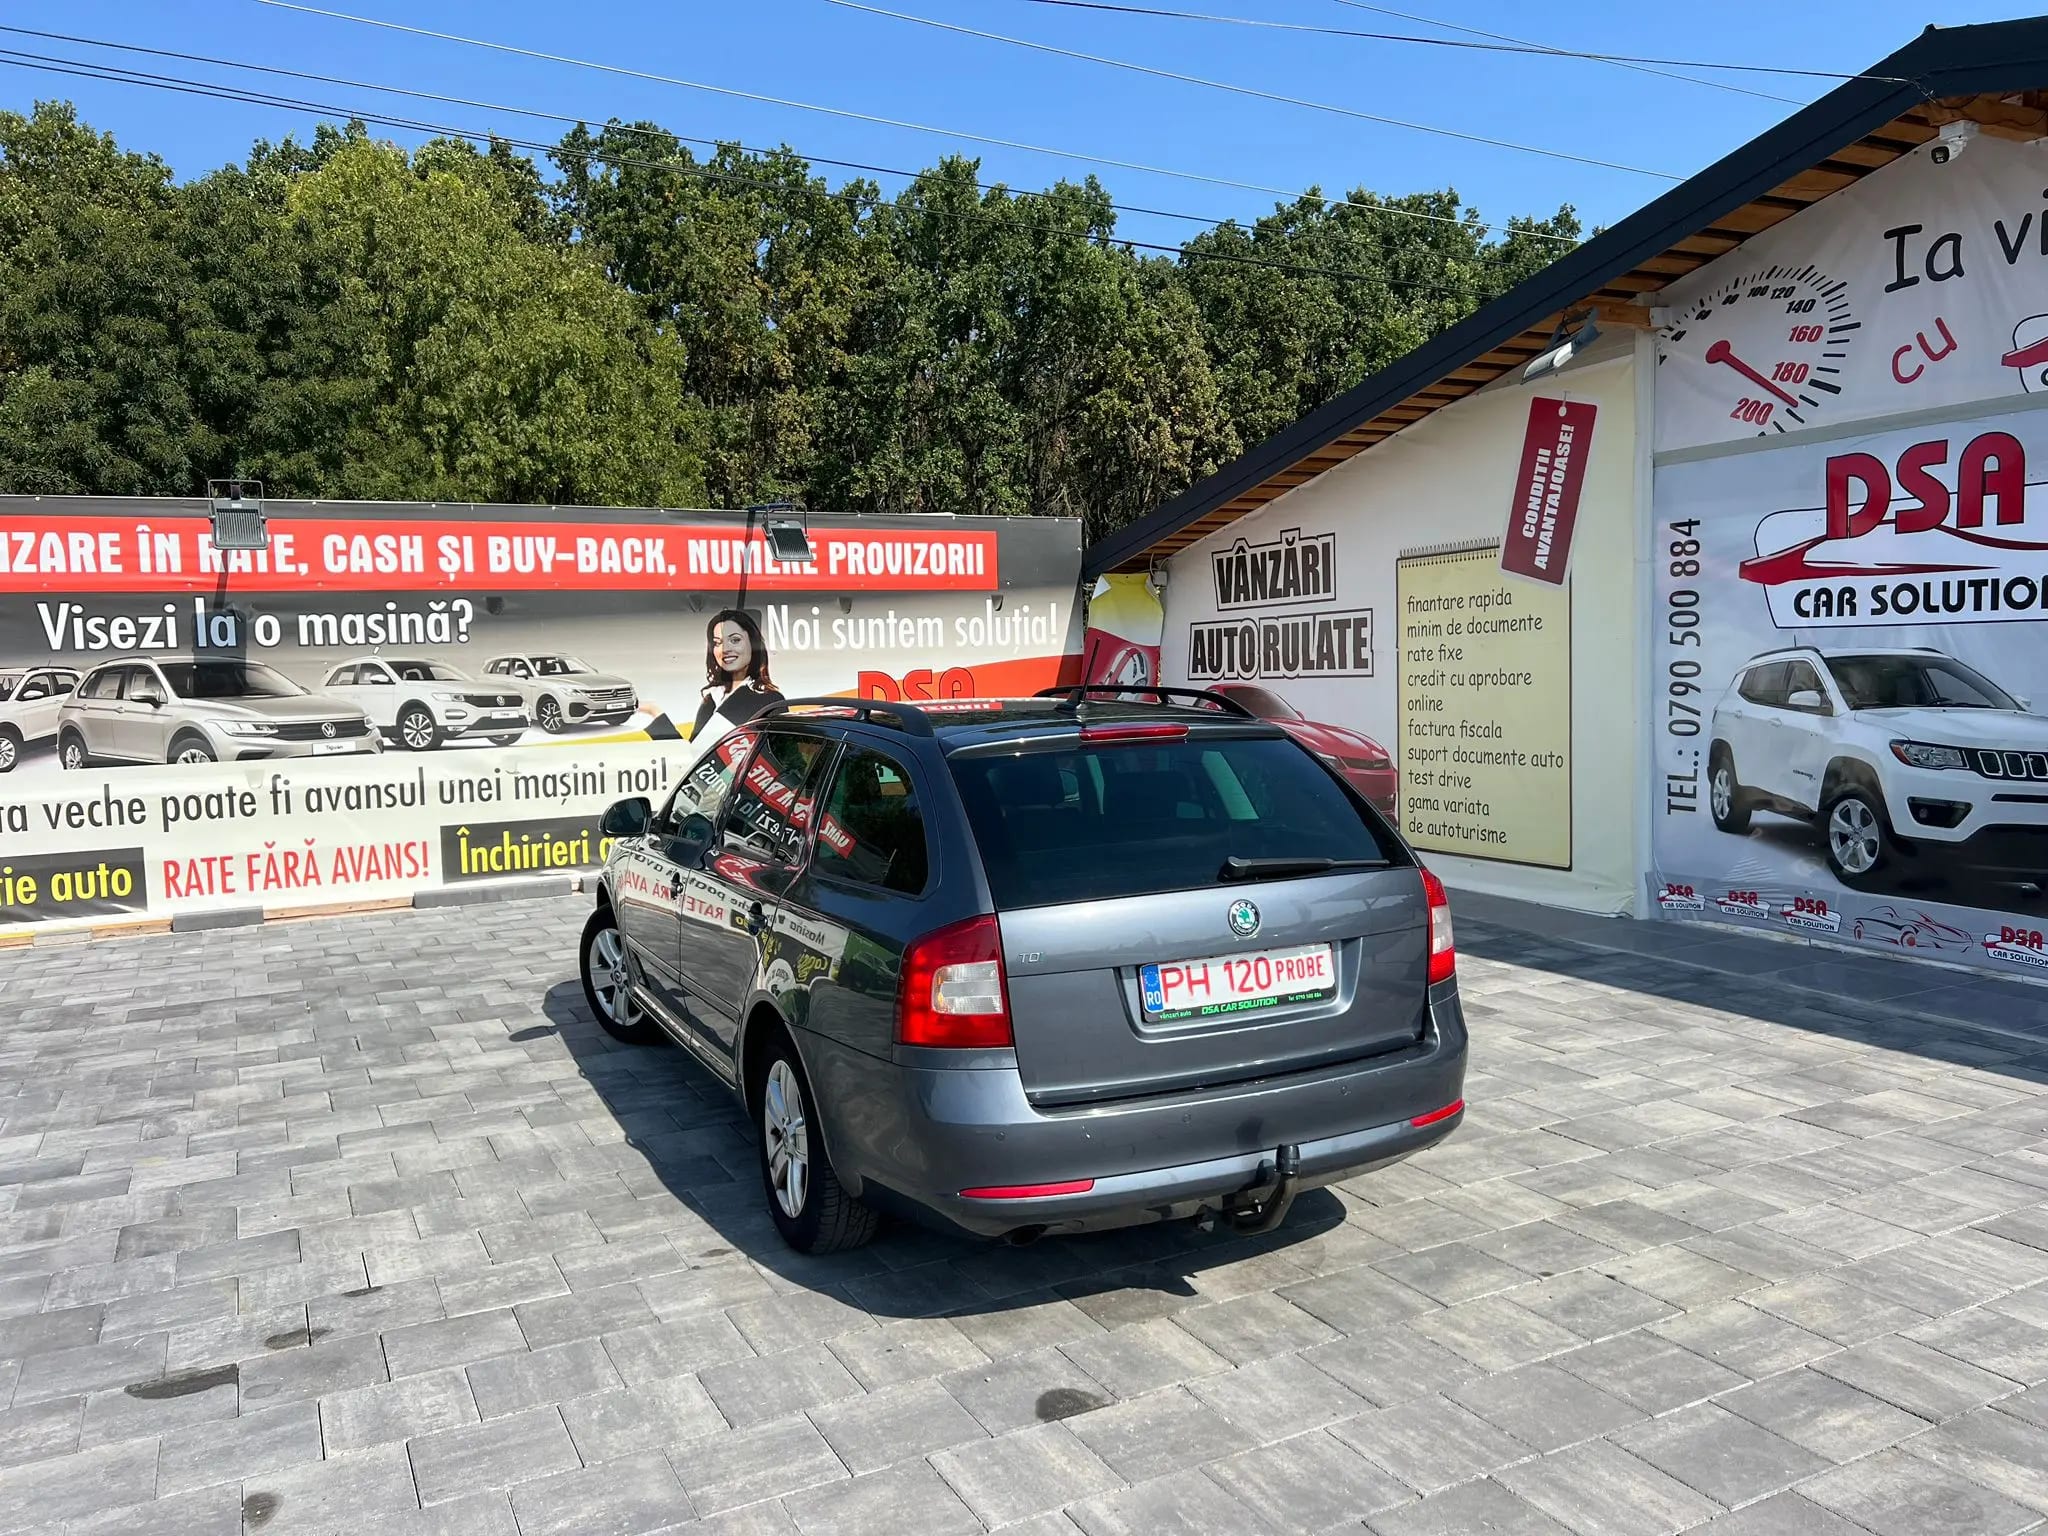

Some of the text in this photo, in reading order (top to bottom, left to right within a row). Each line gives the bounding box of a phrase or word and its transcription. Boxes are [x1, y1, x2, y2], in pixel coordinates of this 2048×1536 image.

[1883, 223, 1965, 293] Ia
[1747, 285, 1770, 298] 100
[1770, 285, 1796, 300] 120
[1785, 299, 1816, 314] 140
[1788, 325, 1824, 343] 160
[1771, 361, 1809, 384] 180
[1730, 397, 1774, 425] 200
[1522, 447, 1551, 539] CONDITII
[1534, 424, 1575, 570] AVANTAJOASE!
[1826, 431, 2026, 540] DSA
[136, 524, 182, 573] ÎN
[322, 534, 424, 573] CASH
[437, 535, 474, 582] ȘI
[487, 536, 677, 576] BUY-BACK,
[829, 542, 985, 576] PROVIZORII
[1669, 518, 1701, 577] 884
[1216, 536, 1332, 604] VÂNZĂRI
[1407, 587, 1512, 614] finantare rapida
[1793, 575, 2048, 618] CAR SOLUTIO
[36, 597, 474, 654] Visezi la o mașină?
[766, 604, 821, 651] Noi
[831, 610, 944, 649] suntem
[1407, 614, 1543, 638] minim de documente
[1669, 589, 1701, 647] 500
[1191, 617, 1369, 674] AUTO RULATE
[1407, 643, 1464, 662] rate fixe
[857, 666, 976, 702] DSA
[1407, 667, 1533, 691] credit cu aprobare
[1407, 695, 1444, 711] online
[1668, 660, 1702, 737] 0790
[1408, 718, 1502, 739] factura fiscala
[1407, 745, 1564, 768] suport documente auto
[1408, 769, 1472, 789] test drive
[42, 783, 147, 830] veche
[161, 785, 257, 832] poate
[270, 774, 292, 816] fi
[305, 766, 427, 813] avansul
[438, 768, 502, 804] unei
[514, 763, 606, 805] mașini
[617, 757, 668, 794] noi!
[1408, 797, 1490, 816] gama variata
[1408, 816, 1507, 844] de autoturisme
[457, 826, 590, 875] Închirieri
[163, 838, 429, 898] RATE FĂRĂ AVANS!
[51, 863, 133, 902] auto
[1736, 908, 1765, 918] SOLUTION
[1794, 896, 1827, 916] DSA
[1789, 917, 1835, 931] CAR SOLUTION
[2001, 925, 2043, 950] DSA
[1993, 950, 2008, 958] CAR
[1147, 955, 1325, 1006] RO PH 120 PROBE
[1201, 996, 1278, 1015] DSA CAR SOLUTION
